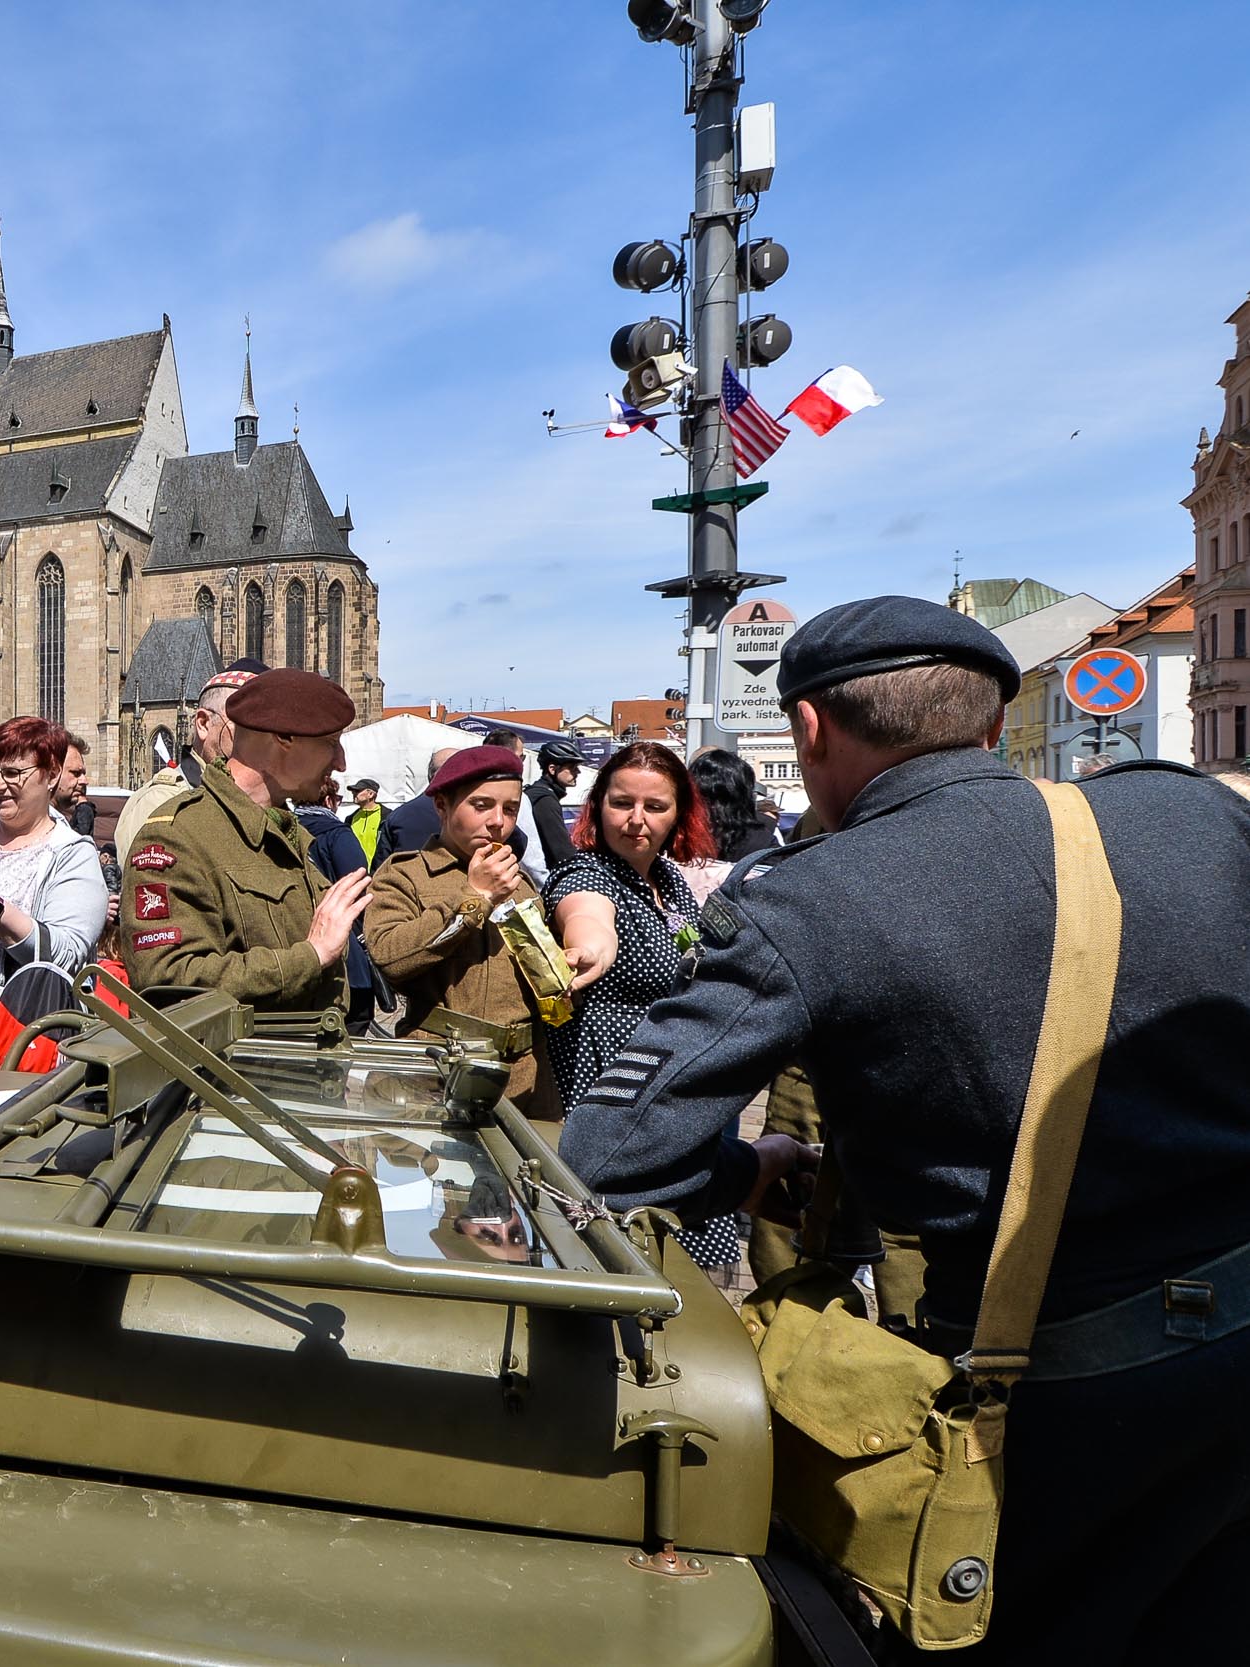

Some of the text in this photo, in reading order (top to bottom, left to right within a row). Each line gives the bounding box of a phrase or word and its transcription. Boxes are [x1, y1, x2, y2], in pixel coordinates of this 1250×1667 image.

[748, 603, 769, 621] A
[733, 624, 785, 637] Parkovací
[736, 640, 778, 653] automat
[744, 684, 767, 694] Zde
[722, 696, 780, 707] vyzvednět
[721, 711, 751, 721] park.
[137, 931, 176, 945] AIRBORNE
